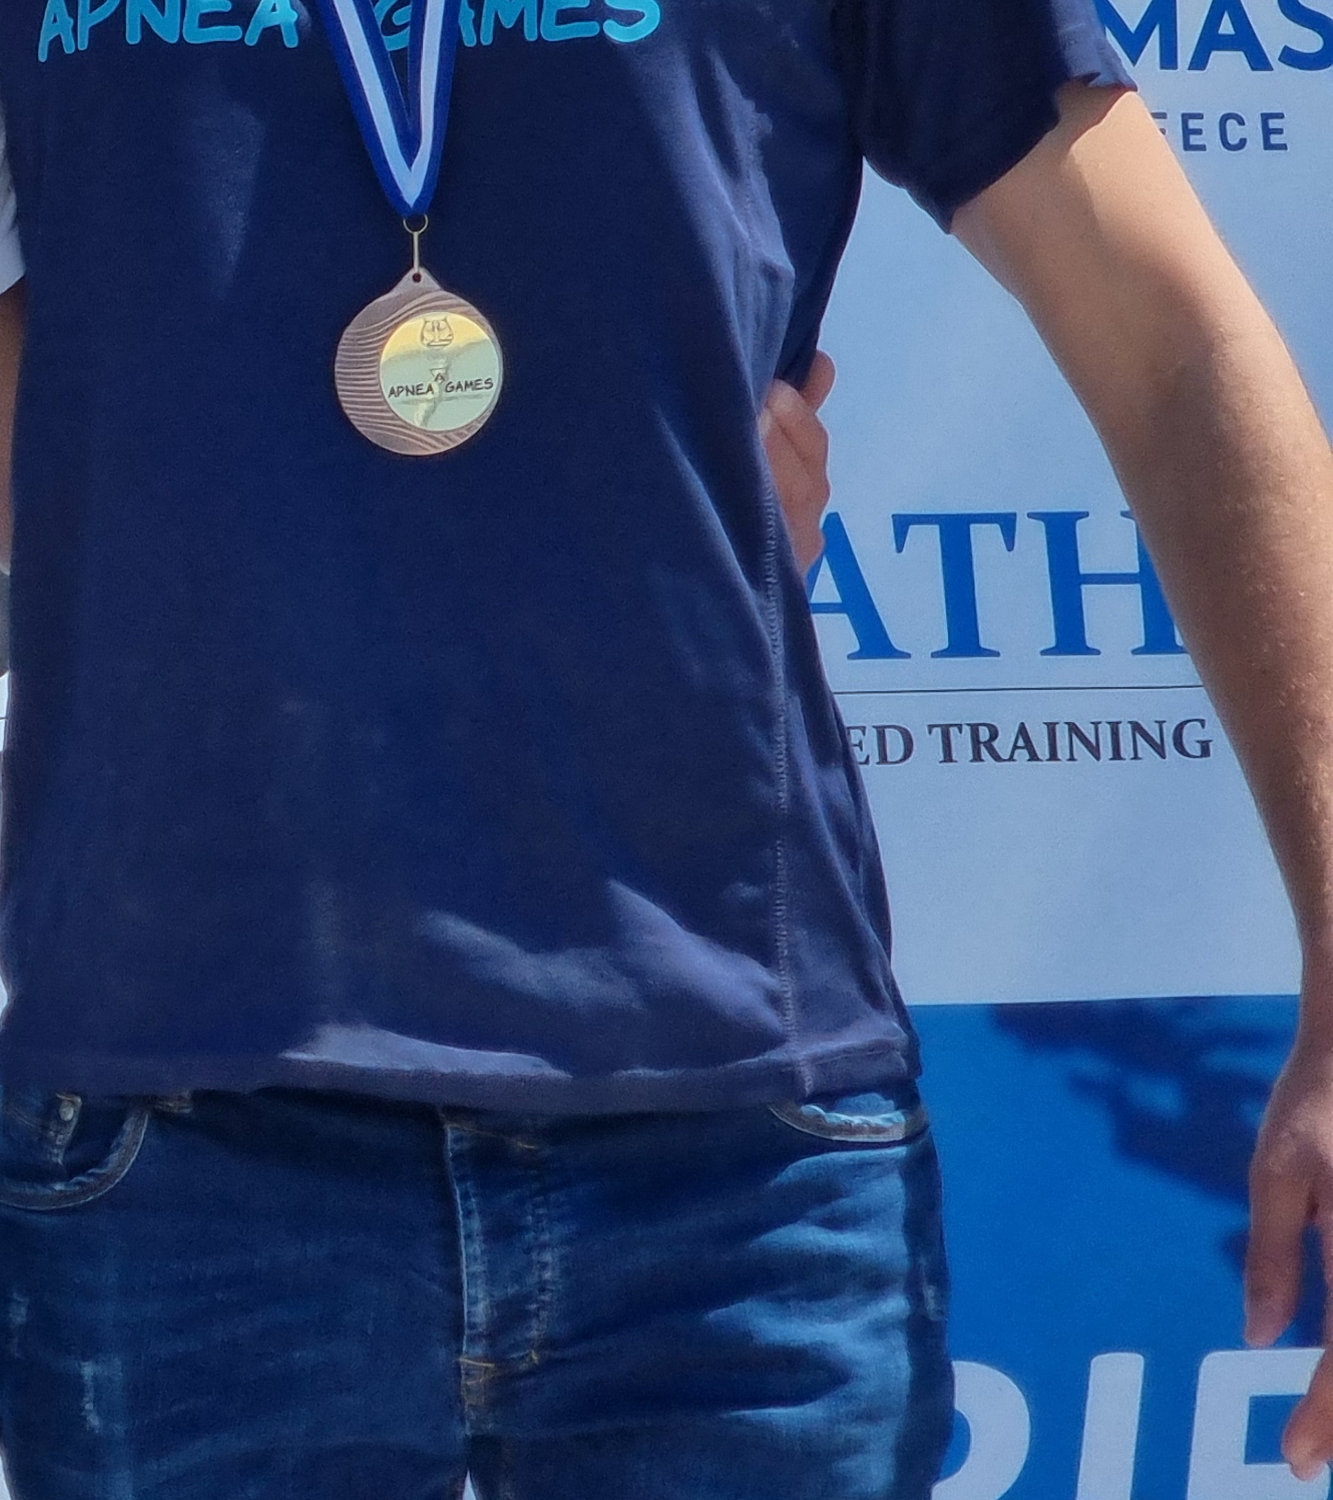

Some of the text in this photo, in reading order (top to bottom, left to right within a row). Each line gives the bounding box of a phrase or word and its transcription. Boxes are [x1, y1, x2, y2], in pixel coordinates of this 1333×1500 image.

[388, 377, 495, 399] APNEA GAMES
[927, 718, 1214, 764] TRAINING
